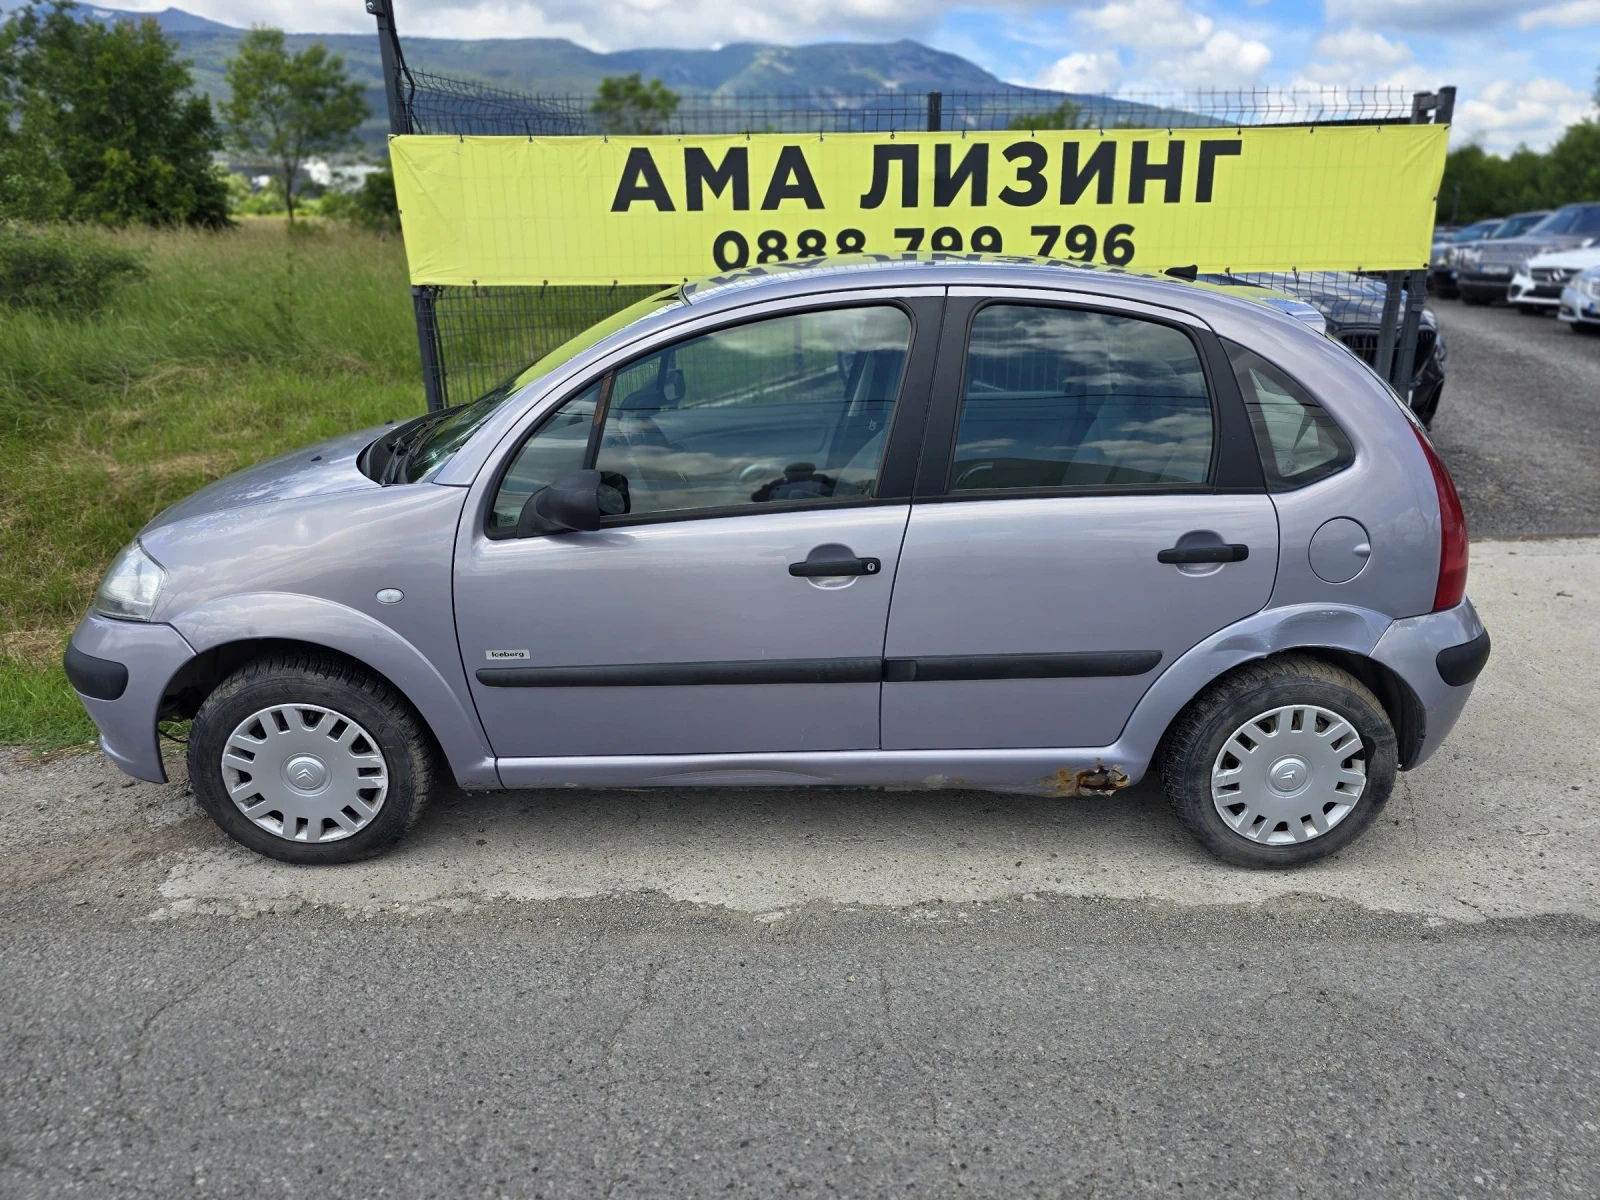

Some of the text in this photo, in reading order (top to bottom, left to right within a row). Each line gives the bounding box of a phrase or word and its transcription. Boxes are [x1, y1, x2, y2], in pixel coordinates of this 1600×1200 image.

[611, 140, 1243, 212] АМА ЛИЗИНГ
[714, 229, 866, 273] 0888
[1030, 224, 1135, 267] 796
